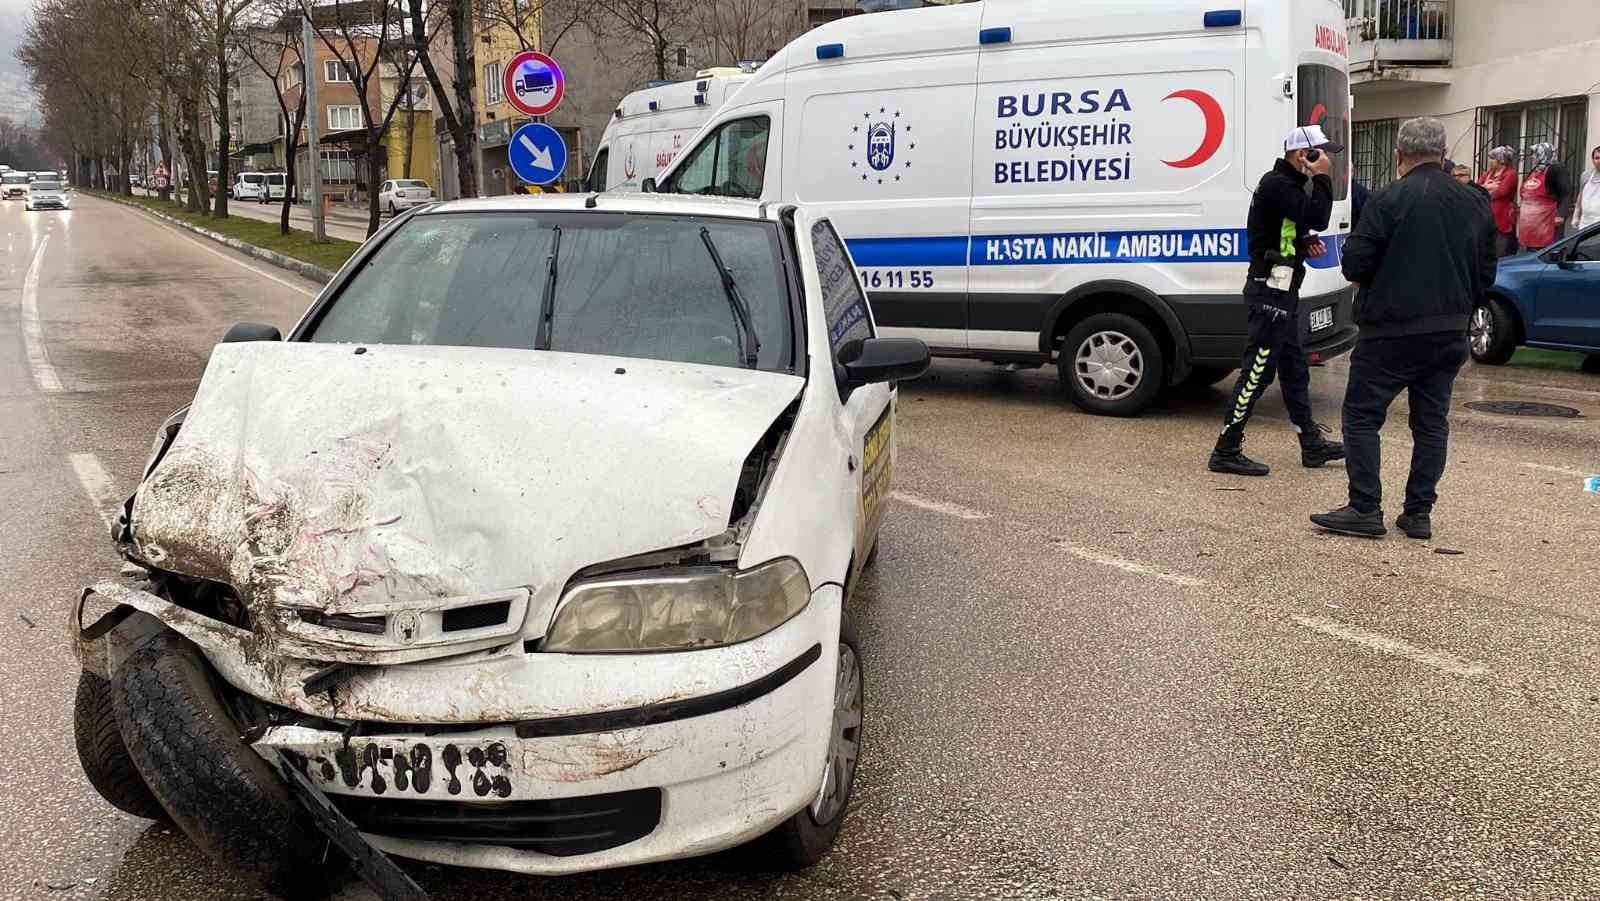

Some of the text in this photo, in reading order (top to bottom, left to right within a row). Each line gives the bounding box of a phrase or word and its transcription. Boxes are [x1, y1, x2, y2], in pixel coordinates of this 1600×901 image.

[997, 88, 1132, 118] BURSA
[995, 118, 1132, 150] BÜYÜKŞEHİR
[994, 152, 1131, 183] BELEDİYESİ
[987, 232, 1239, 260] HASTA NAKİL AMBULANSI
[861, 270, 934, 288] 16 11 55
